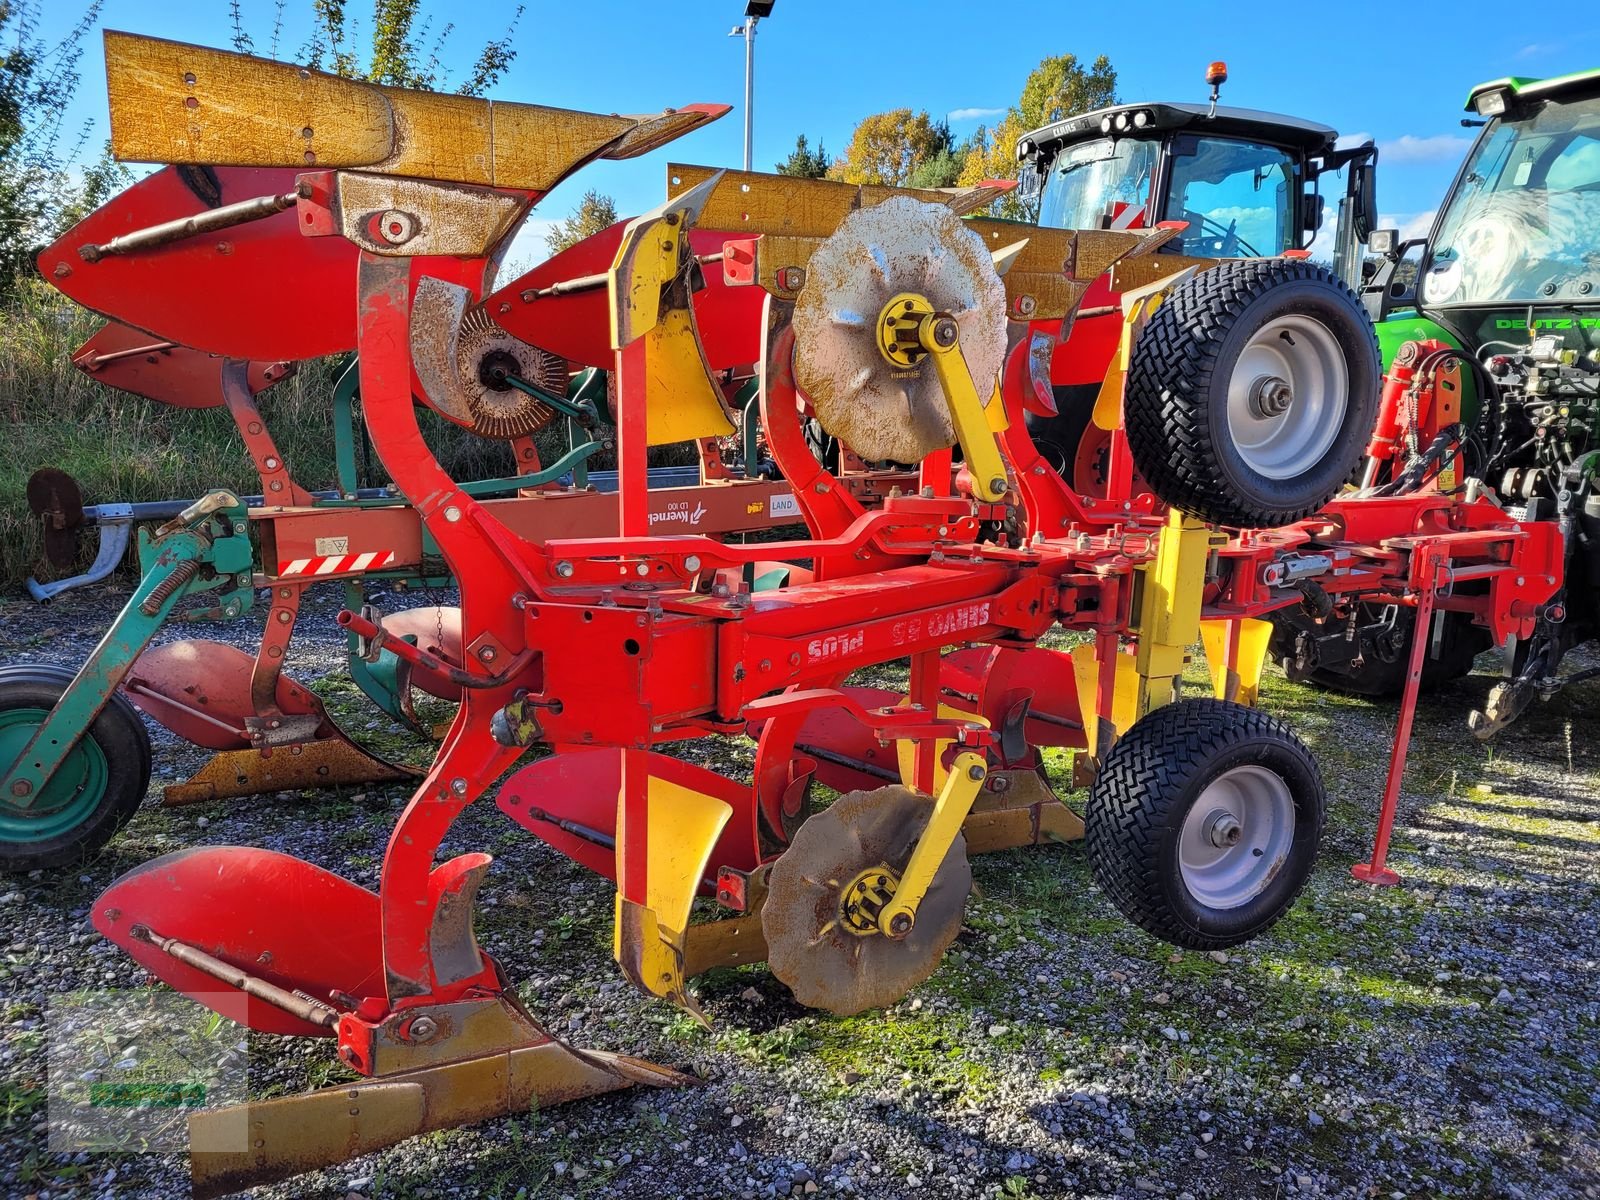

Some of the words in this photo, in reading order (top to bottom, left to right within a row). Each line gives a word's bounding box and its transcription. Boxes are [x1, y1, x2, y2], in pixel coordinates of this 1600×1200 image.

[667, 502, 678, 511] 100
[772, 500, 793, 510] LAND
[647, 510, 689, 526] Kvernel
[928, 602, 990, 637] SERVO
[807, 629, 865, 664] PLUS
